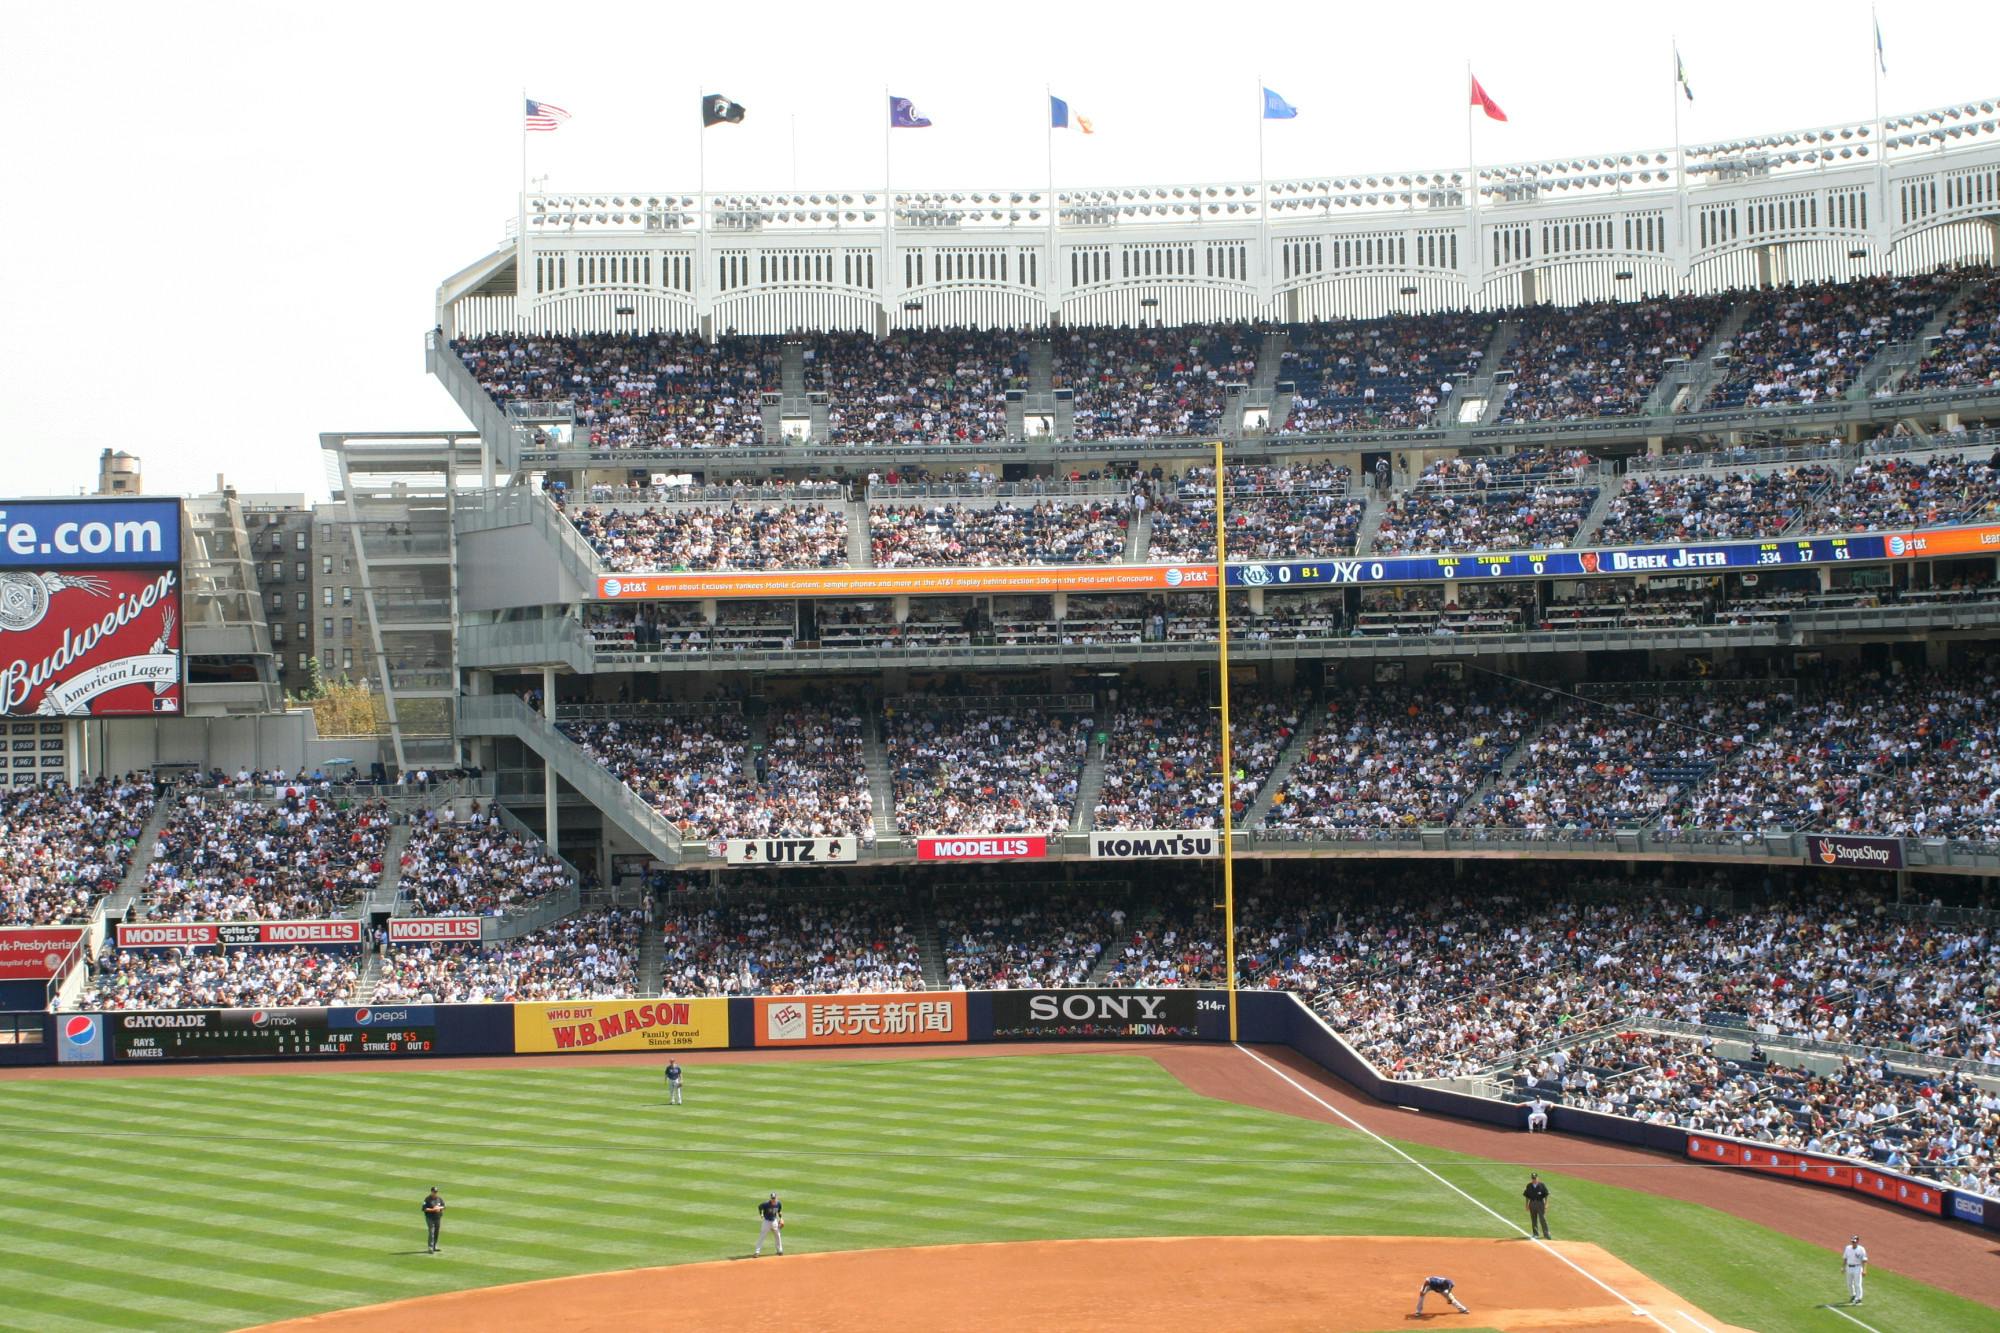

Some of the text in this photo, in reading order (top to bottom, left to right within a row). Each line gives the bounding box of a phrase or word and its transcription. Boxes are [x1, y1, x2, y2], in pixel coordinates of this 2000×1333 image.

[1438, 554, 1548, 566] BALL STRIKE OUT
[1613, 549, 1727, 570] DEREK JETER
[1756, 548, 1850, 564] .334 17 61
[1184, 571, 1208, 582] at&t
[1279, 566, 1291, 583] 0
[1371, 563, 1384, 579] 0
[1444, 566, 1454, 578] 0
[1491, 563, 1501, 576] 0
[1533, 562, 1544, 575] 0
[622, 582, 647, 592] at&t
[678, 583, 699, 591] about
[701, 583, 733, 591] Exclusive
[766, 581, 788, 589] Mobile
[1078, 575, 1094, 583] Field
[1096, 575, 1115, 583] Level
[0, 570, 176, 714] Budweiser
[64, 664, 173, 706] American Lager
[766, 840, 815, 861] UTZ
[935, 840, 1028, 857] MODELL'S
[1098, 834, 1211, 856] KOMATSU
[1836, 844, 1889, 864] Stop&Shop
[126, 928, 209, 943] MODELL'S
[219, 926, 260, 934] Gotta Go
[269, 925, 354, 940] MODELL'S
[392, 922, 479, 937] MODELL'S
[547, 1008, 593, 1020] WHO BUT
[1030, 994, 1166, 1020] SONY
[124, 1015, 206, 1028] GATORADE
[270, 1017, 297, 1025] max
[374, 1010, 408, 1022] pepsi
[811, 1001, 952, 1036] 読売新聞
[641, 1029, 700, 1040] Family Owned
[1129, 1023, 1166, 1035] HDNA
[133, 1038, 155, 1047] RAYS
[328, 1034, 338, 1043] AT
[339, 1034, 353, 1042] BAT
[361, 1033, 368, 1043] 2
[387, 1032, 402, 1041] POS
[648, 1037, 693, 1046] Since 1898
[126, 1048, 163, 1058] YANKEES
[320, 1041, 430, 1052] BALL 0 STRIKE 0 OUT 0
[1955, 1198, 1984, 1216] GEICO
